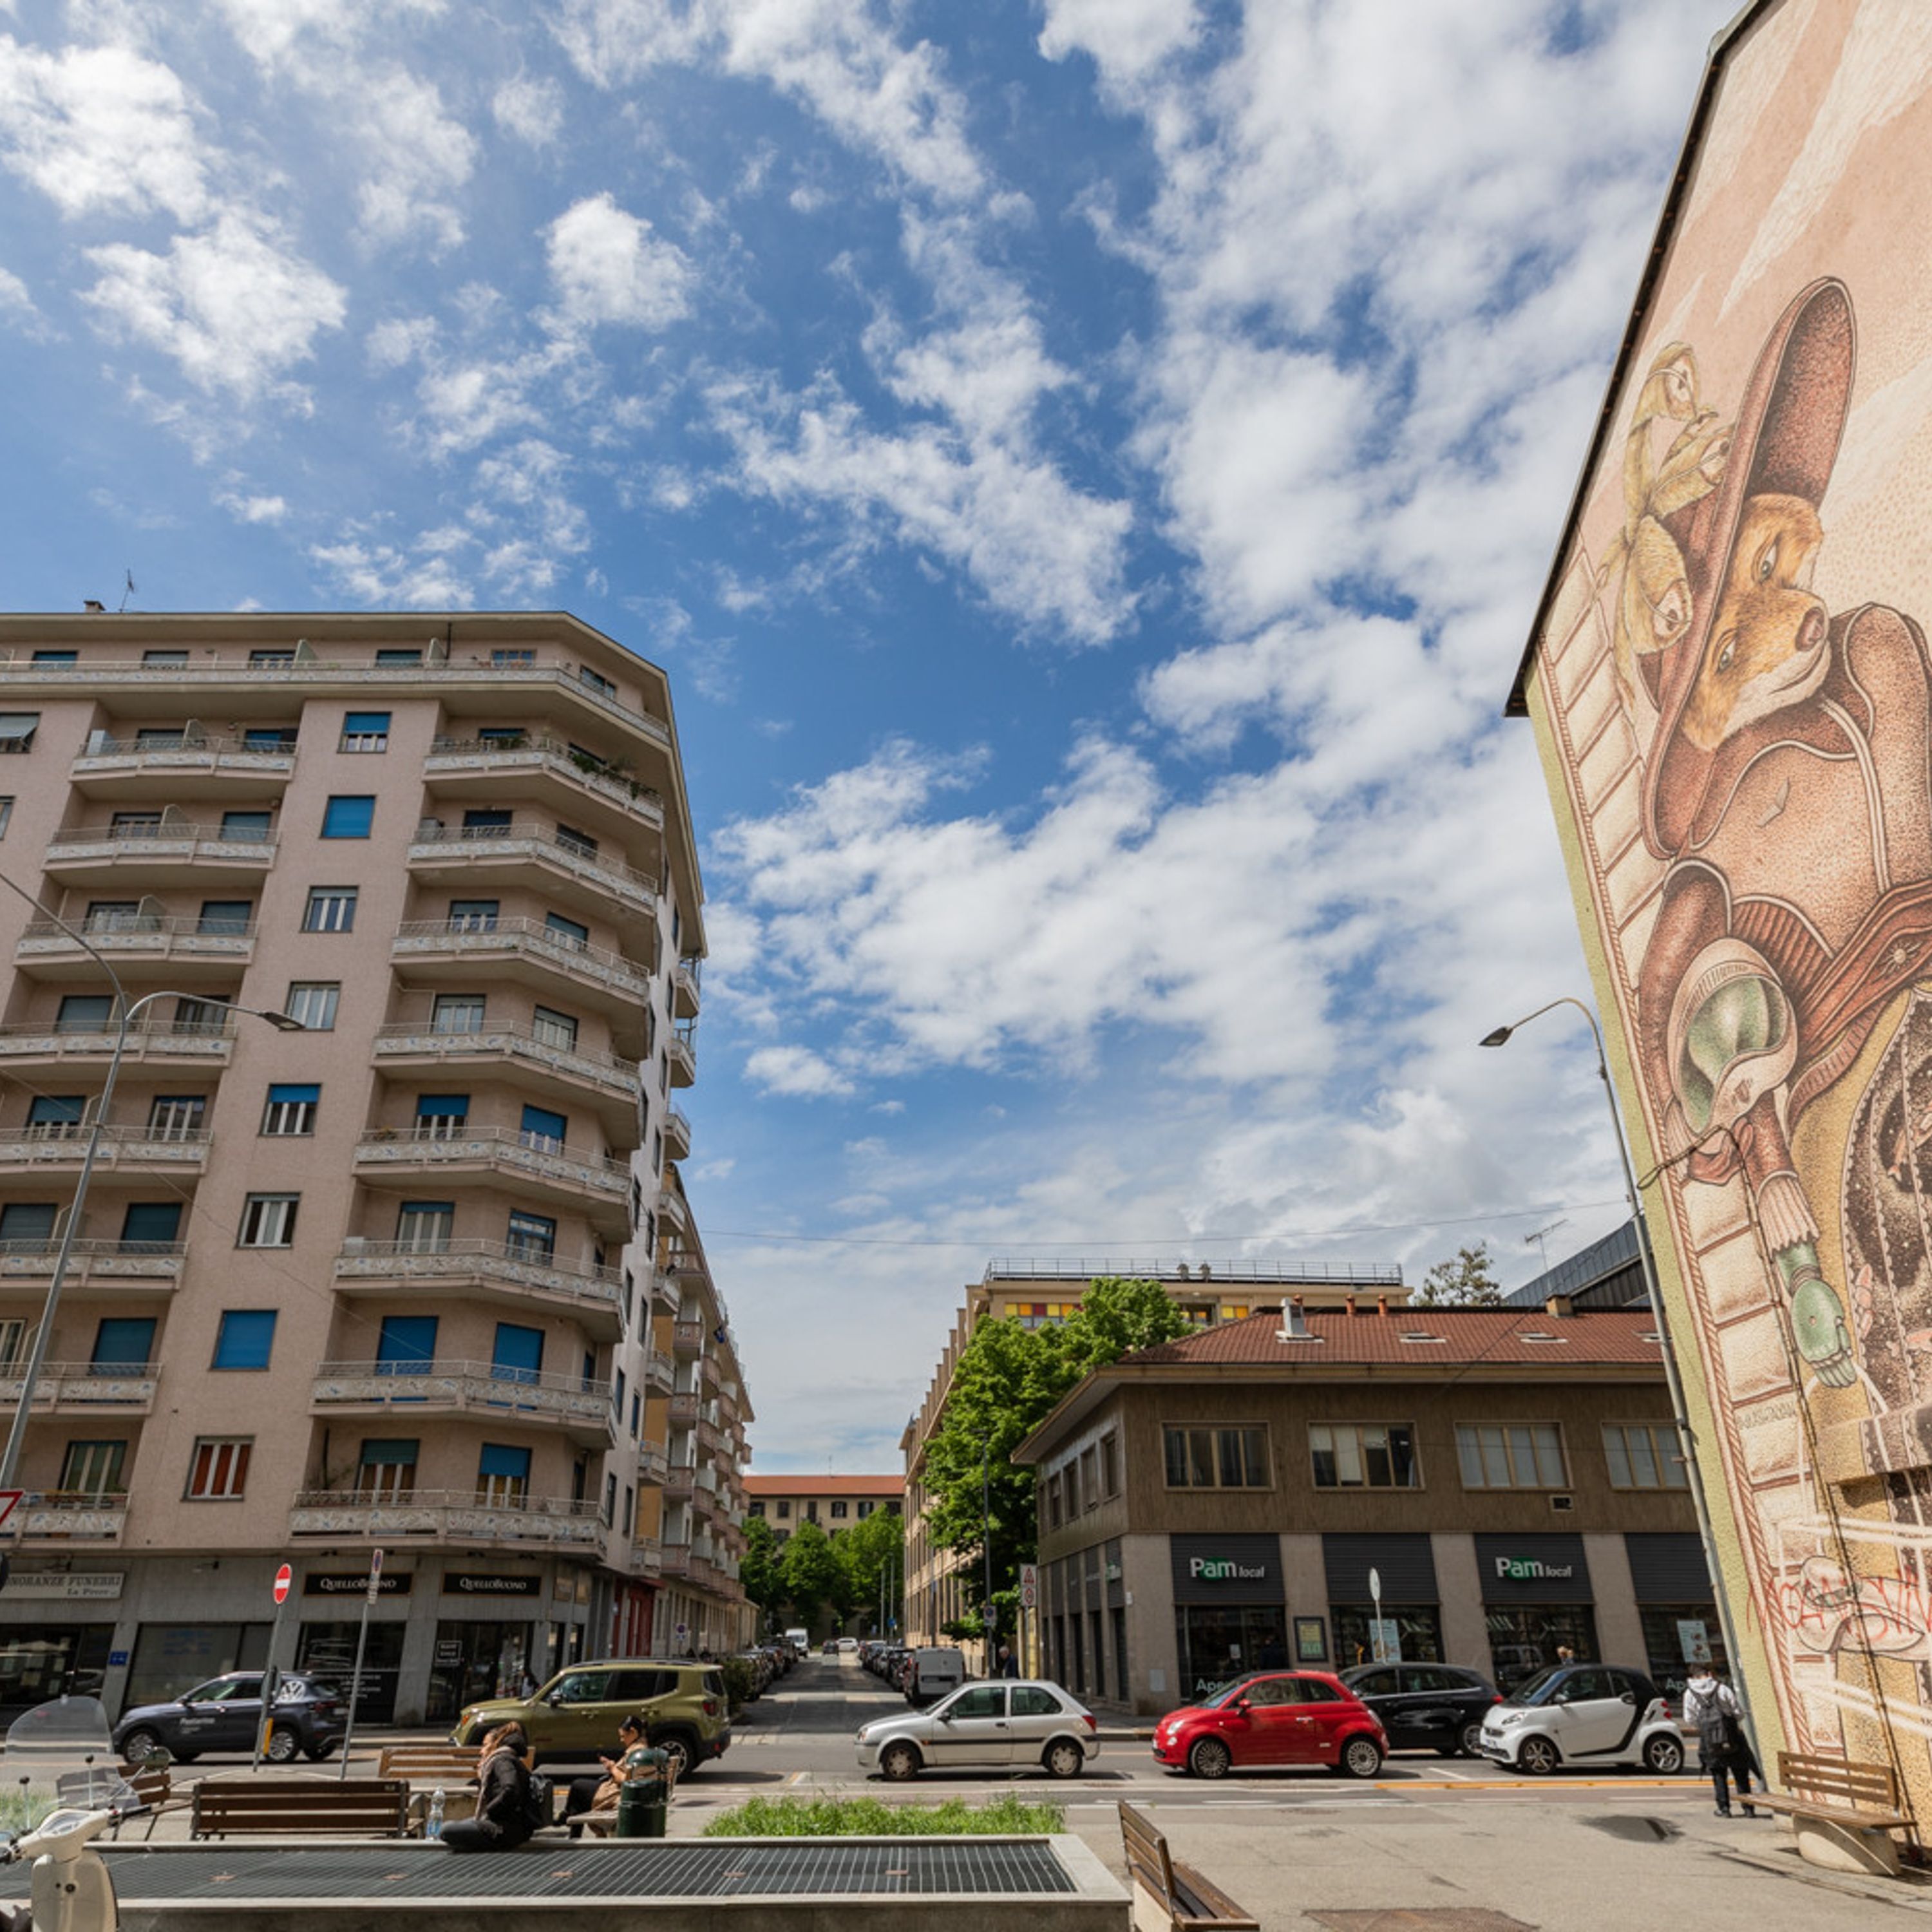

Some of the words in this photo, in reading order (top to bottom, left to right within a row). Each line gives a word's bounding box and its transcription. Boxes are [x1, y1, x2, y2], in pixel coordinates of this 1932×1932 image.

[1190, 1557, 1237, 1578] Pam
[1238, 1566, 1265, 1578] local
[1495, 1557, 1544, 1578] Pam
[1546, 1565, 1572, 1578] local
